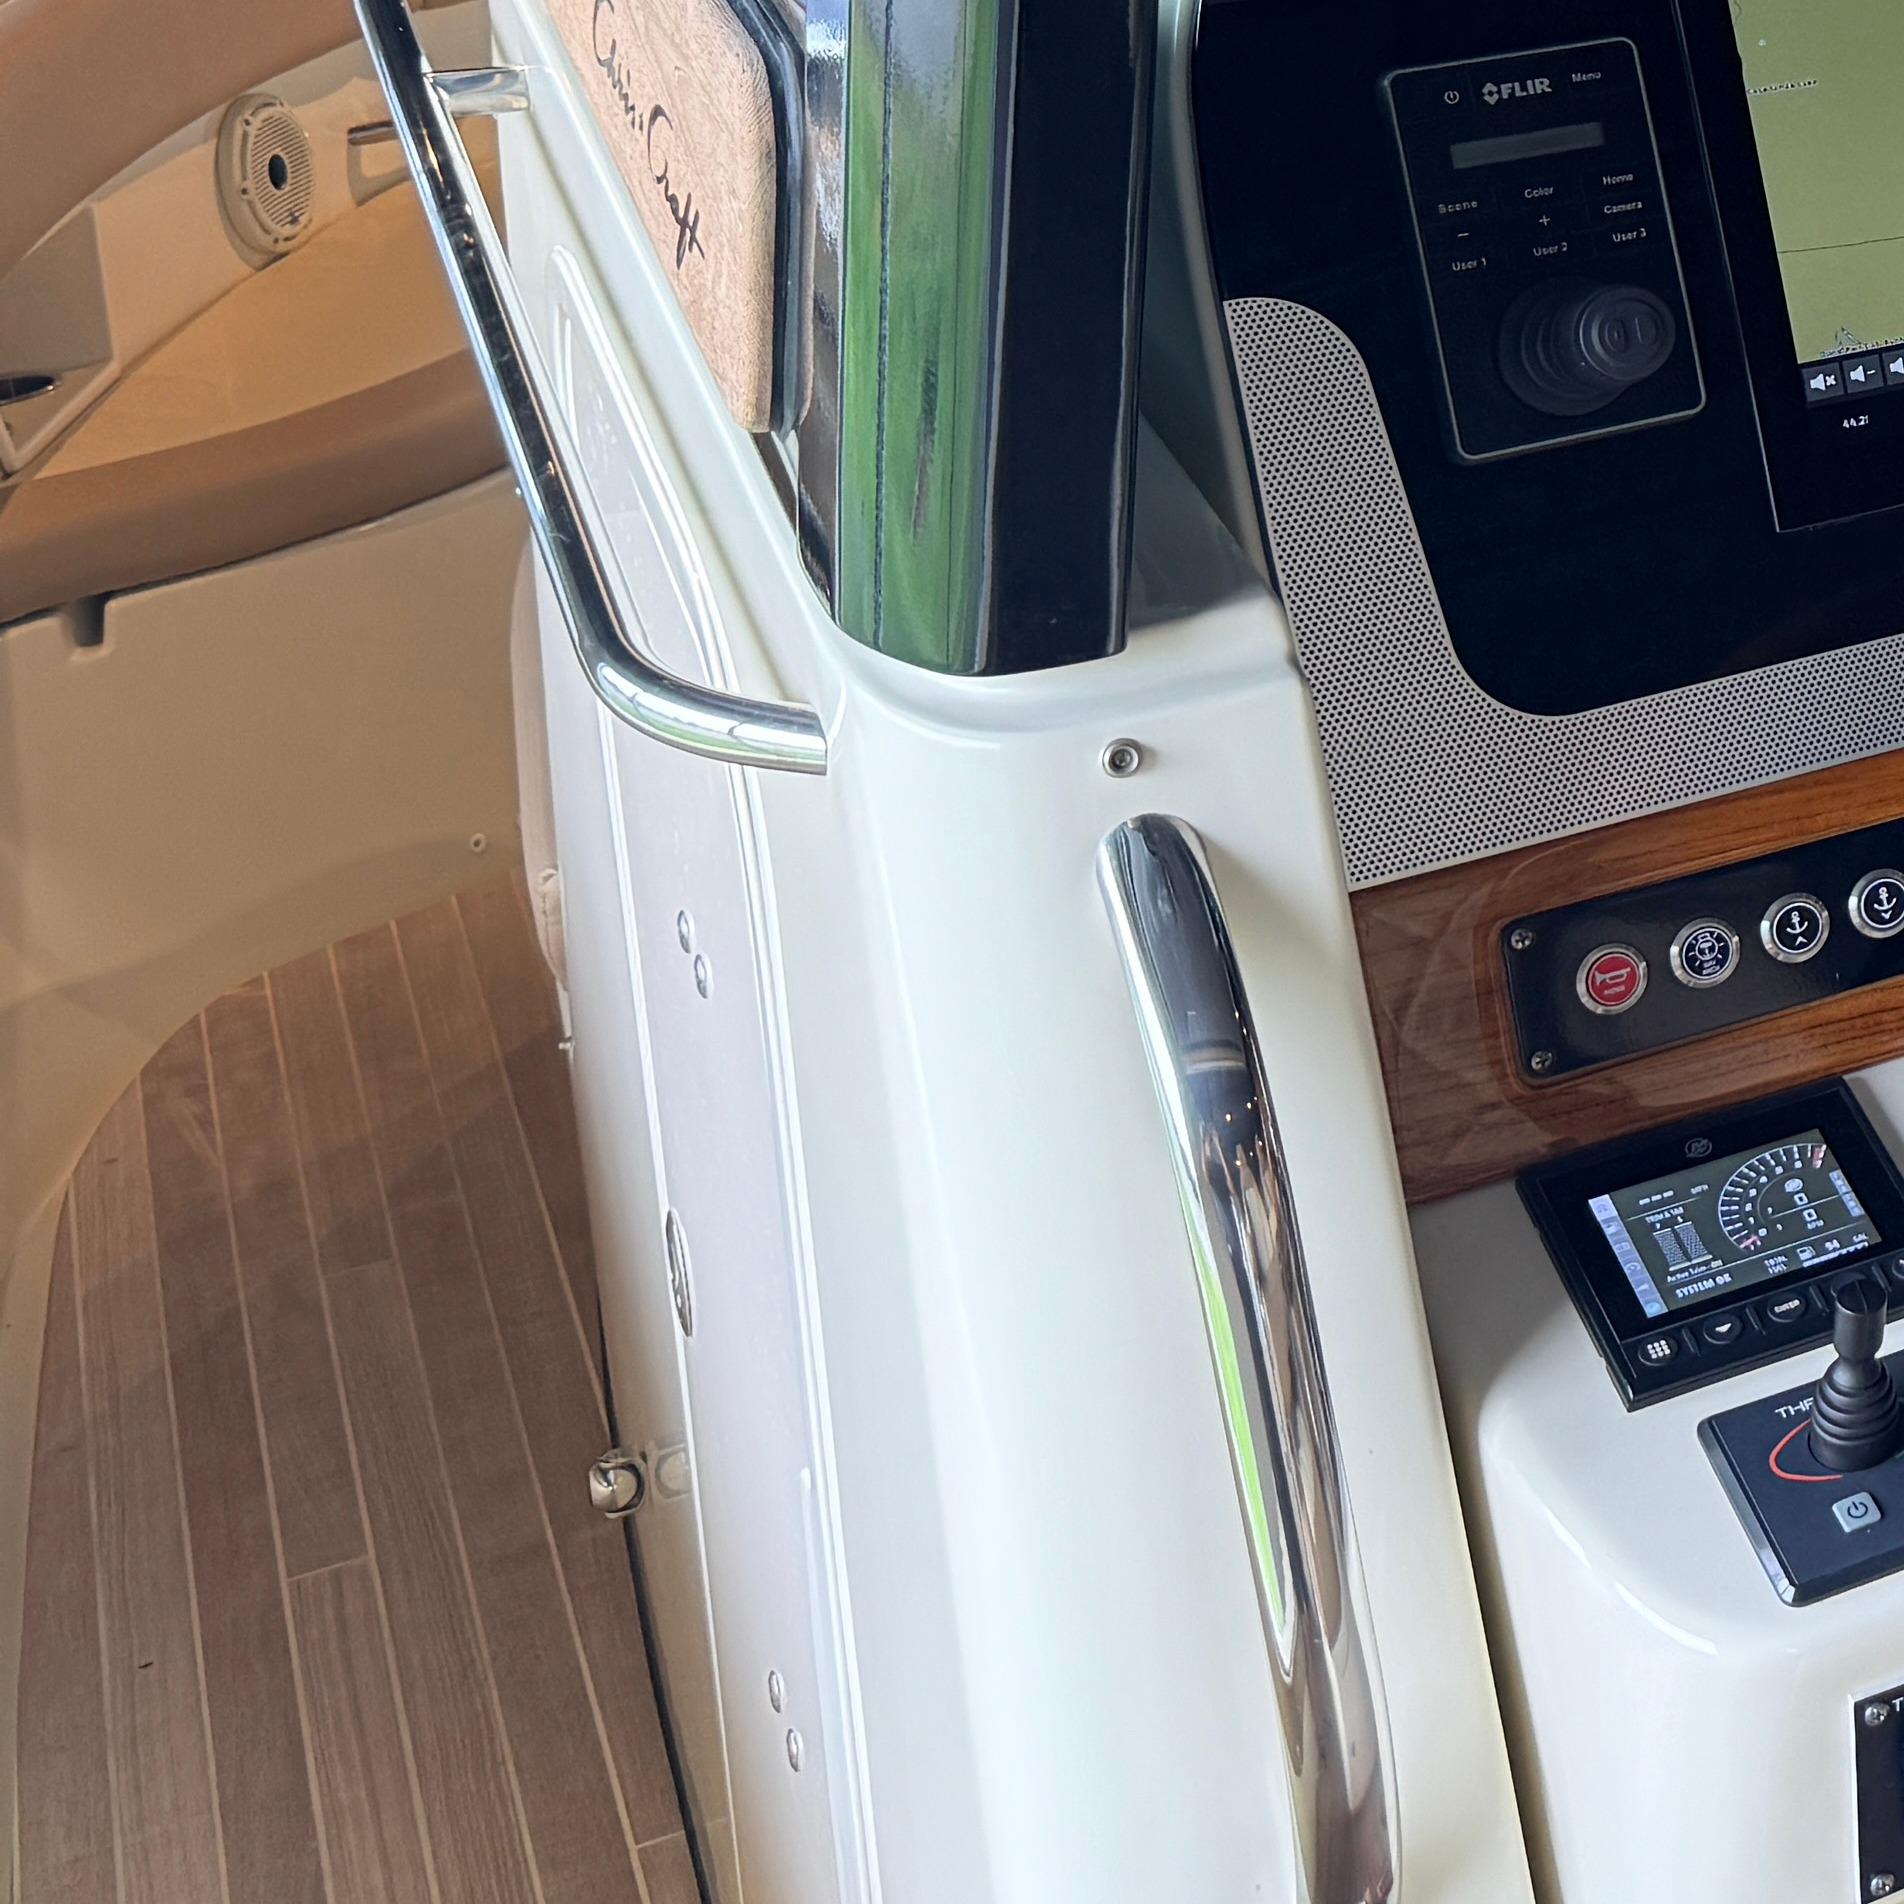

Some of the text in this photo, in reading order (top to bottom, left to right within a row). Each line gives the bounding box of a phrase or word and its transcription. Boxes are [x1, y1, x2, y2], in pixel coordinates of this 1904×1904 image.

[1500, 77, 1553, 100] FLIR
[1603, 200, 1643, 215] Camera
[1612, 231, 1639, 244] User
[1533, 244, 1560, 257] User
[1452, 259, 1479, 273] User
[1675, 1277, 1715, 1300] SYSTEM
